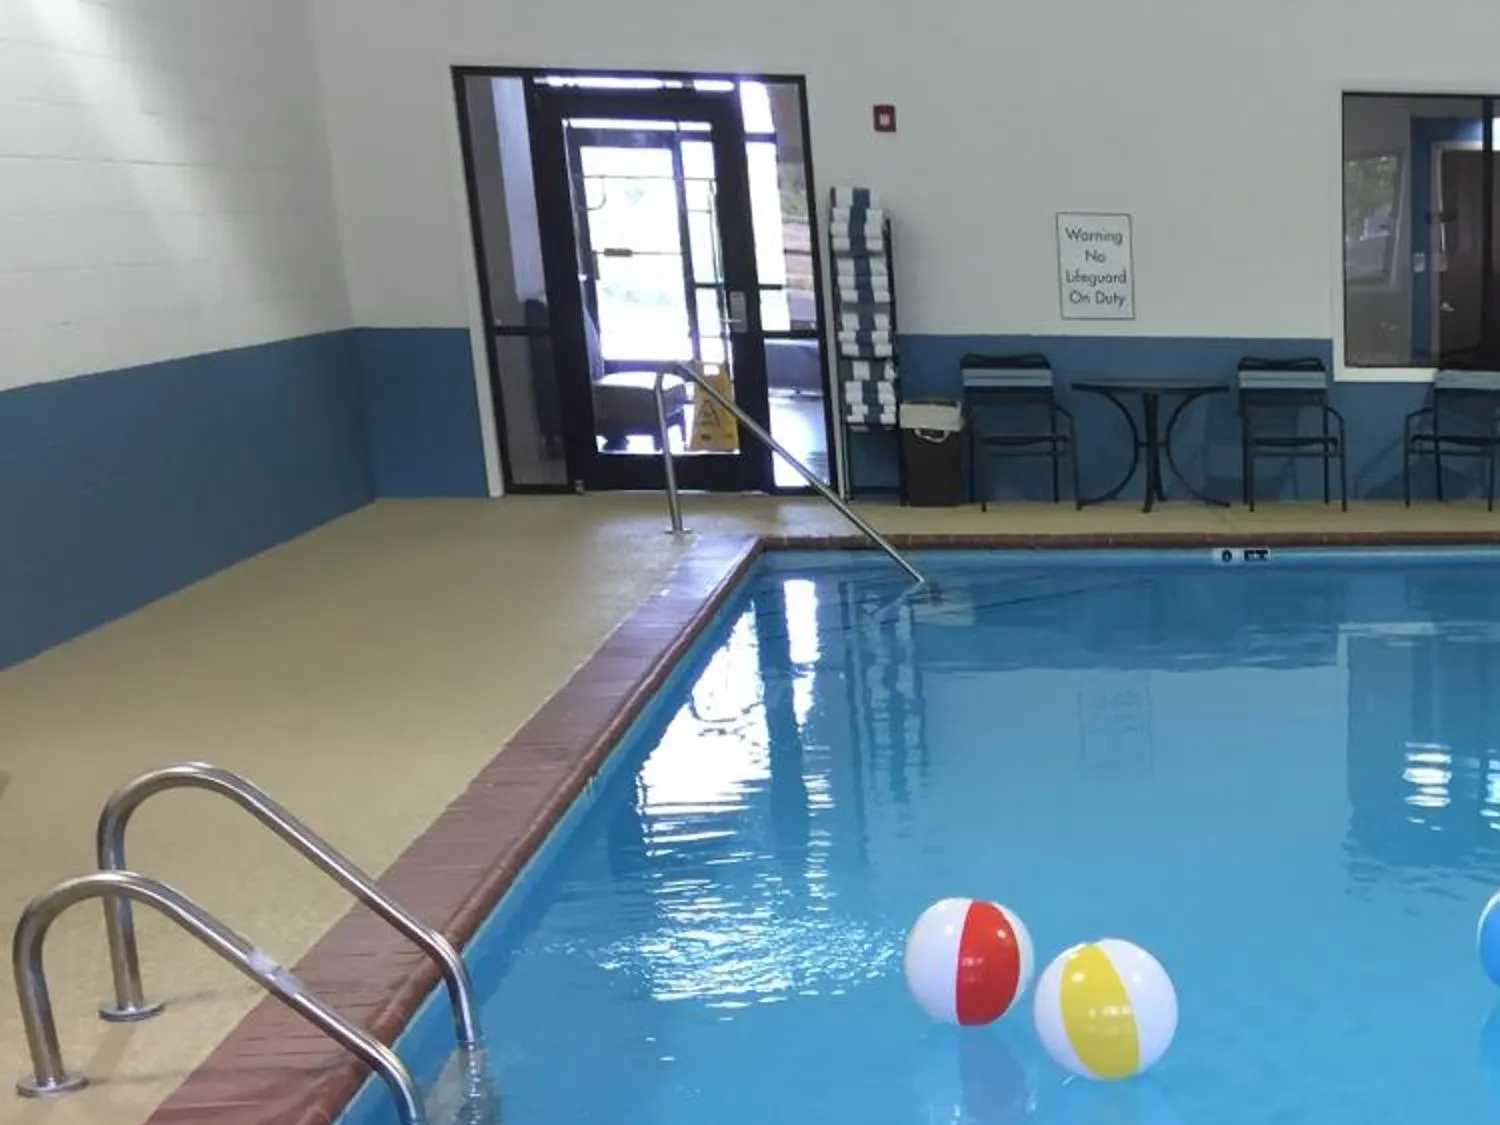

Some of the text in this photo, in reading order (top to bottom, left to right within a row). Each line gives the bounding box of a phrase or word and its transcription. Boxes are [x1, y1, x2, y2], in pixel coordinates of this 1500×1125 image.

[1064, 225, 1123, 247] Warning
[1085, 248, 1107, 264] No
[1065, 267, 1127, 287] Lifeguard
[1069, 290, 1126, 307] On Duty
